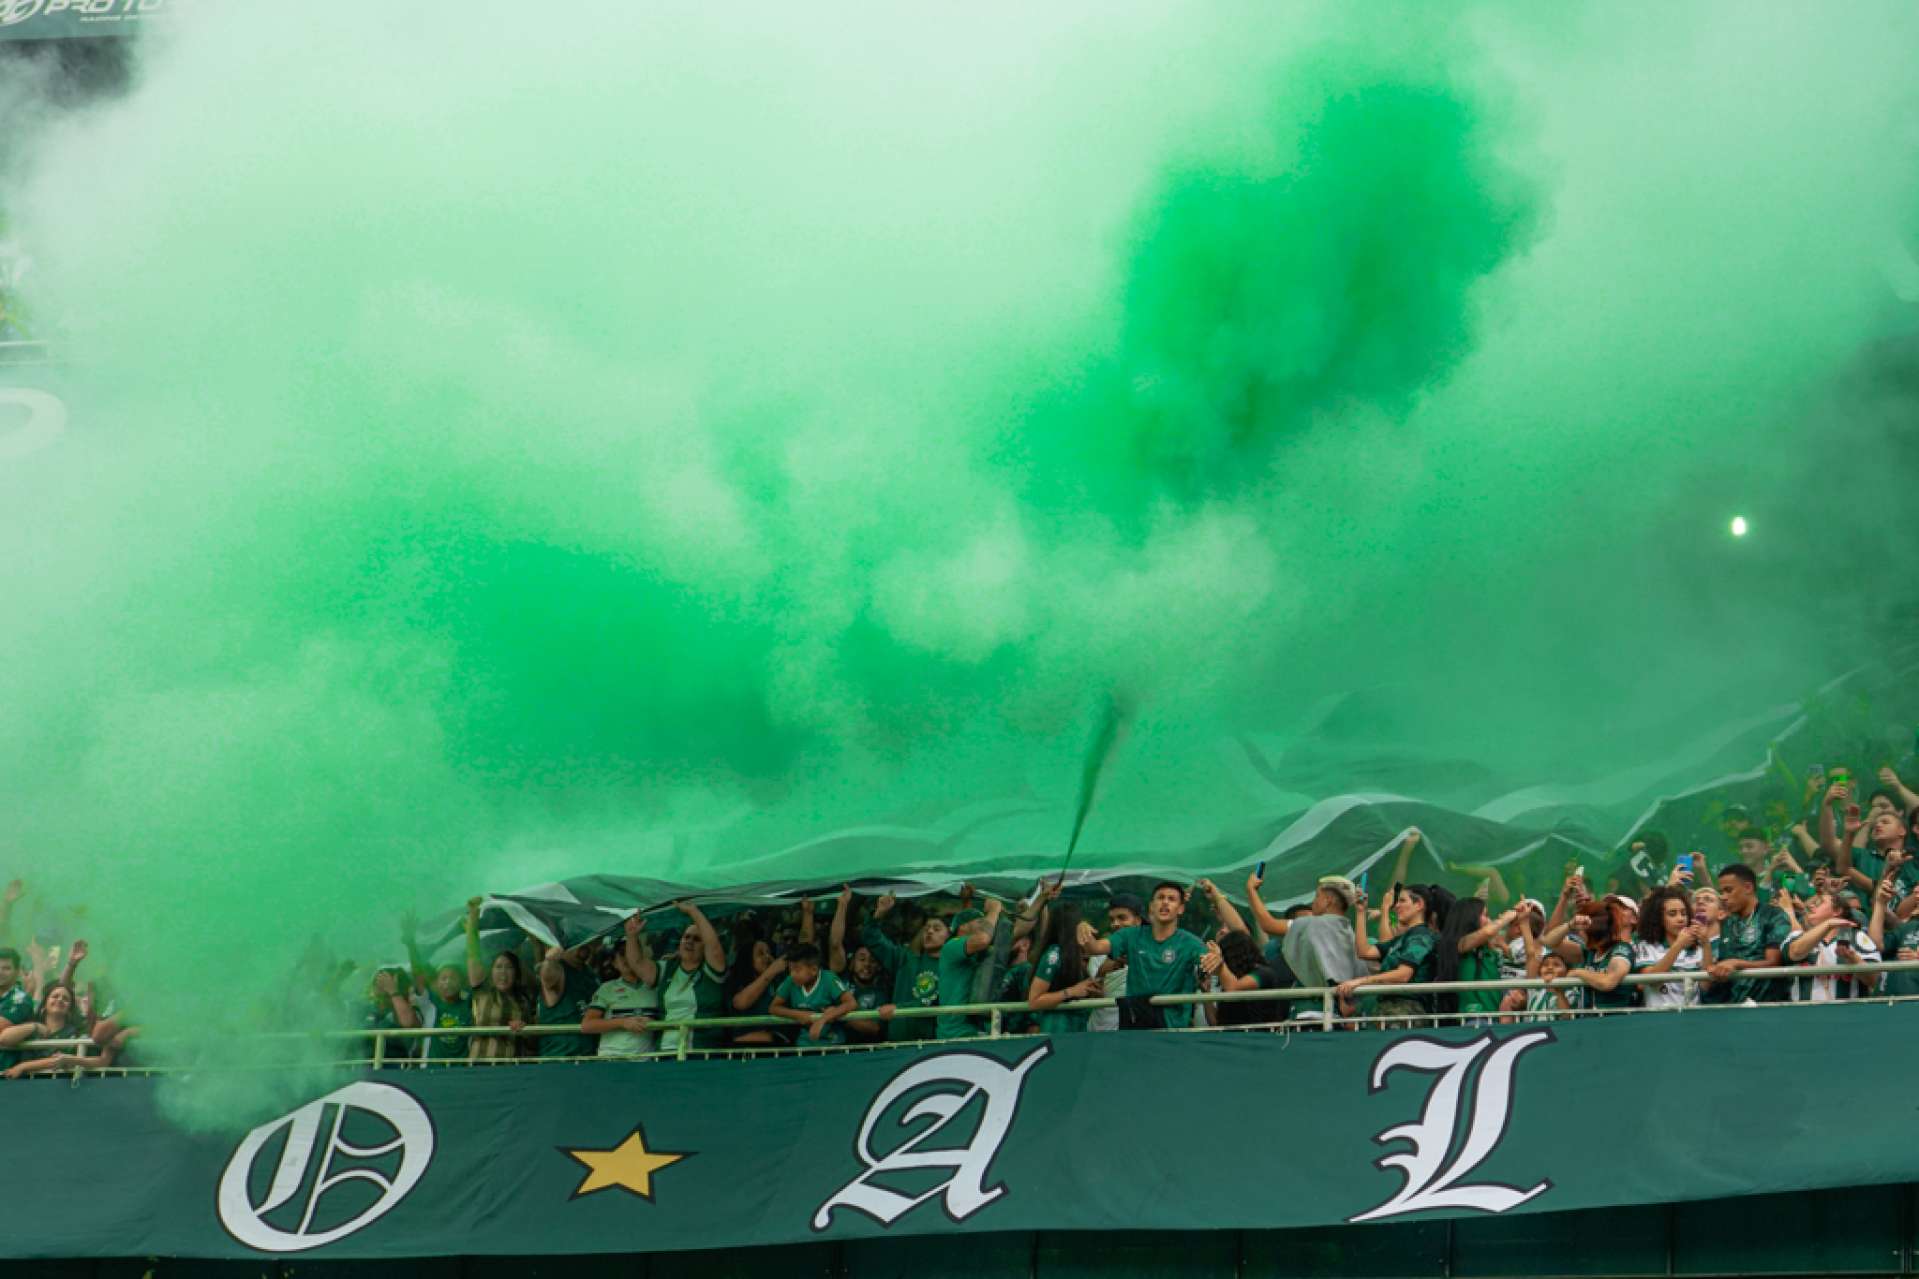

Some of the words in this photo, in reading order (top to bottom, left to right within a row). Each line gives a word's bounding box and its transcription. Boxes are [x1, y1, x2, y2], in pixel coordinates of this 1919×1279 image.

[217, 1081, 435, 1253] O
[813, 1044, 1050, 1229] A
[1348, 1030, 1549, 1223] L
